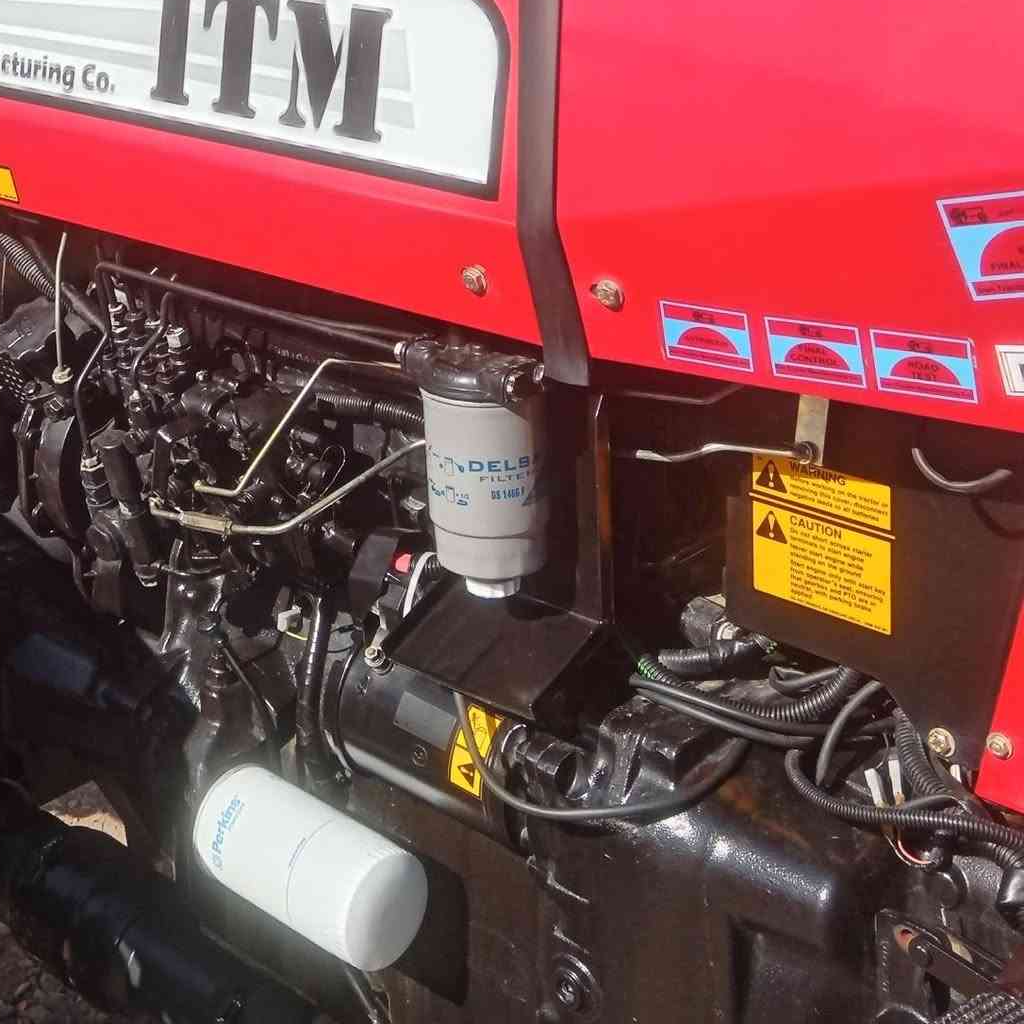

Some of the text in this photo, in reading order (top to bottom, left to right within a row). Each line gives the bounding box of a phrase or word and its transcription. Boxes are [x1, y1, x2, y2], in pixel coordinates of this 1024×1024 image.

[81, 64, 115, 95] Co.
[790, 462, 846, 486] WARNING
[790, 515, 842, 539] CAUTION
[211, 798, 242, 856] Perkins
